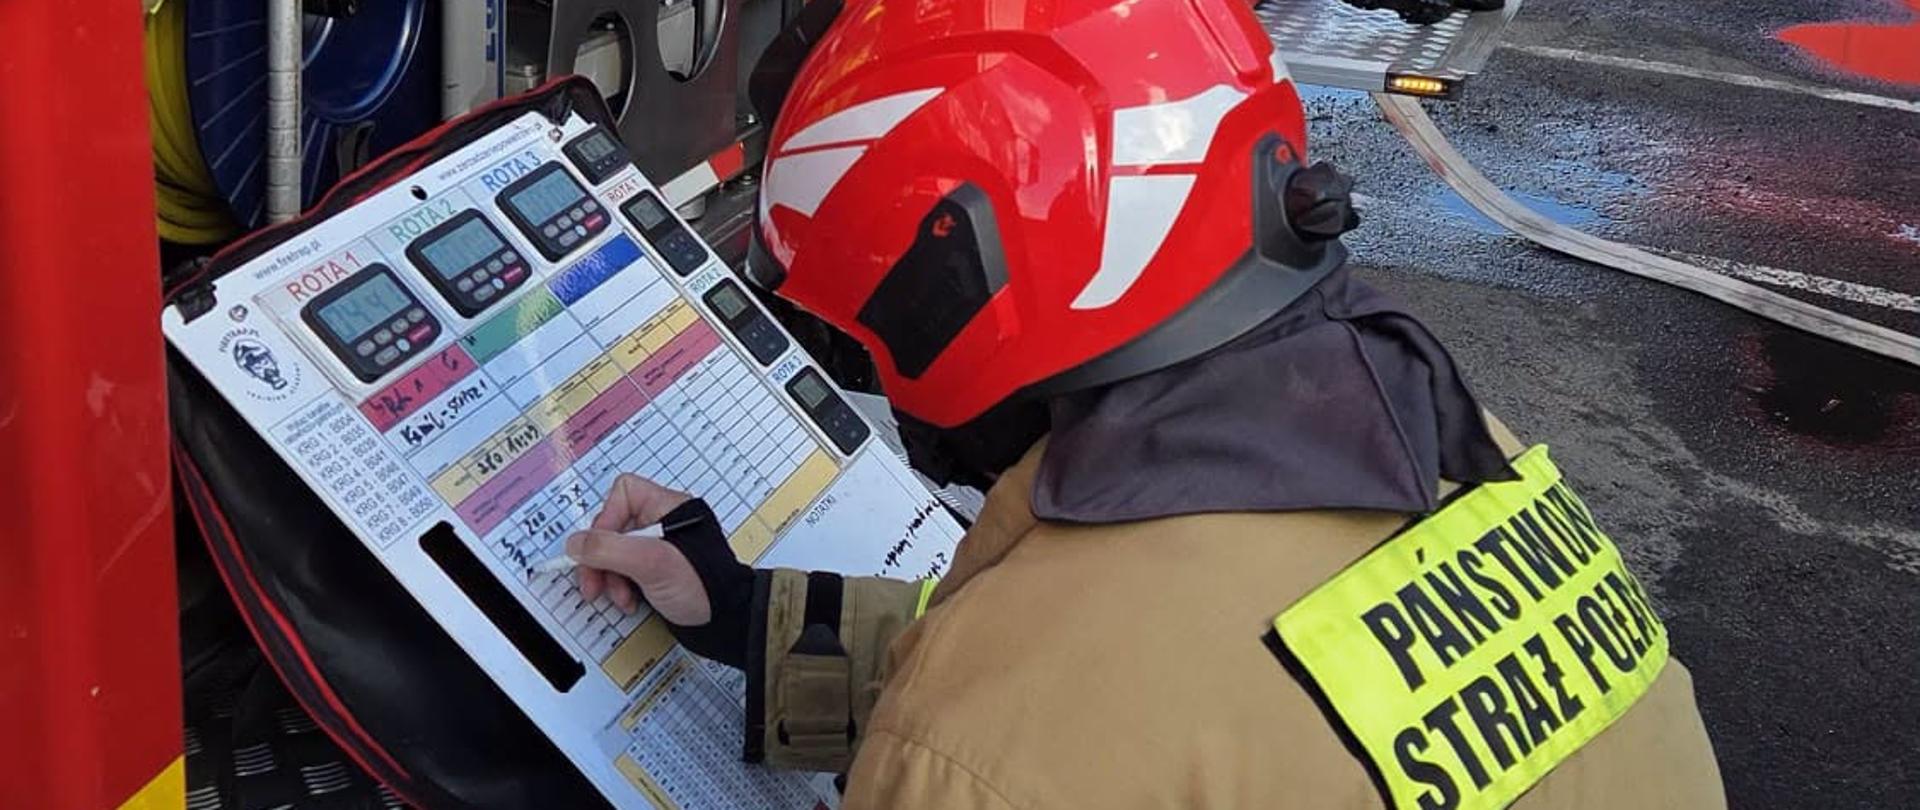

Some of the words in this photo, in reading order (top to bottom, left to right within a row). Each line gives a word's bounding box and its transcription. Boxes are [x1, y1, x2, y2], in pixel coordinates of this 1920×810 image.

[481, 156, 530, 192] ROTA
[526, 150, 543, 168] 3
[607, 182, 635, 202] ROTA
[388, 206, 446, 243] ROTA
[440, 199, 458, 217] 2
[286, 263, 349, 302] ROTA
[345, 252, 362, 273] 1
[689, 270, 716, 293] ROTA
[771, 359, 798, 383] ROTA
[298, 437, 320, 455] KRG
[309, 450, 332, 467] KRG
[320, 461, 343, 480] KRG
[331, 473, 355, 492] KRG
[344, 485, 367, 503] KRG
[355, 497, 378, 517] KRG
[805, 494, 836, 528] NOTATKI
[367, 510, 389, 529] KRG
[379, 522, 401, 542] KRG
